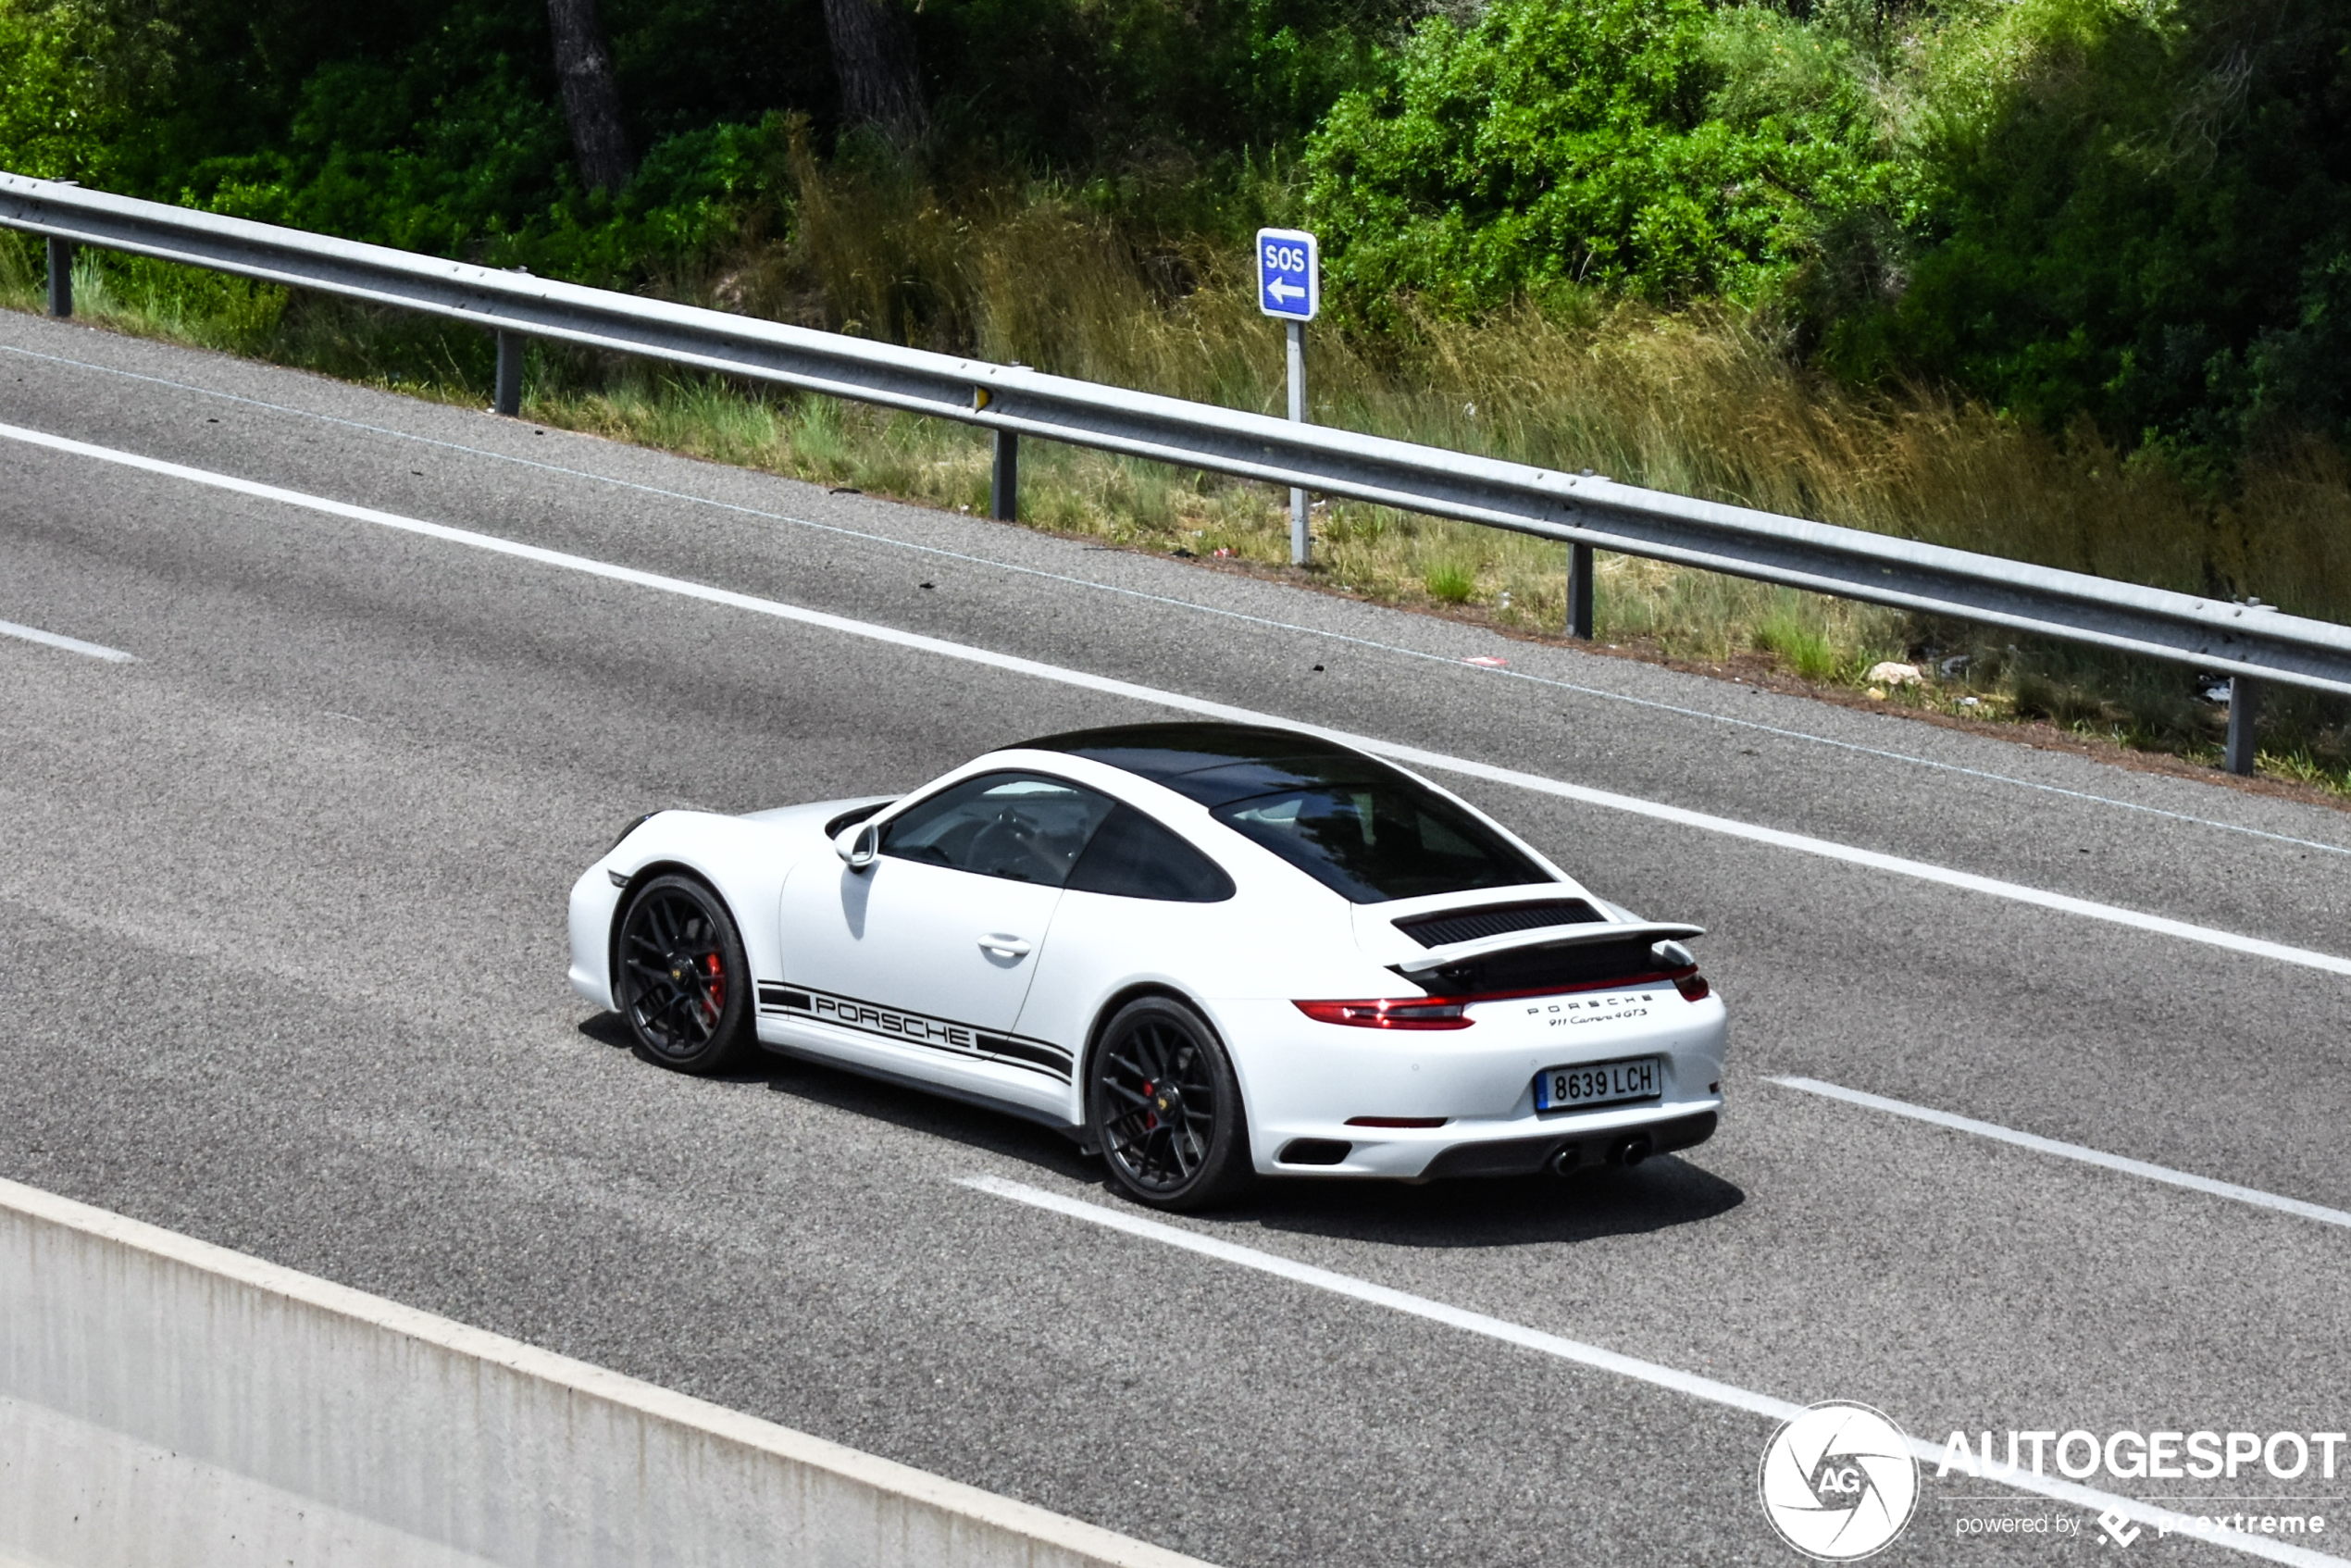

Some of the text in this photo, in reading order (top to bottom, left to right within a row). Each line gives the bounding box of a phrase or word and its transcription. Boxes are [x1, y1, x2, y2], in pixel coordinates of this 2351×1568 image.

[1265, 244, 1305, 272] SOS
[1527, 994, 1653, 1015] PORSCHE
[815, 997, 971, 1048] PORSCHE
[1549, 1018, 1567, 1027] 911
[1570, 1015, 1613, 1025] Carrera
[1555, 1064, 1652, 1101] 8639 LCH
